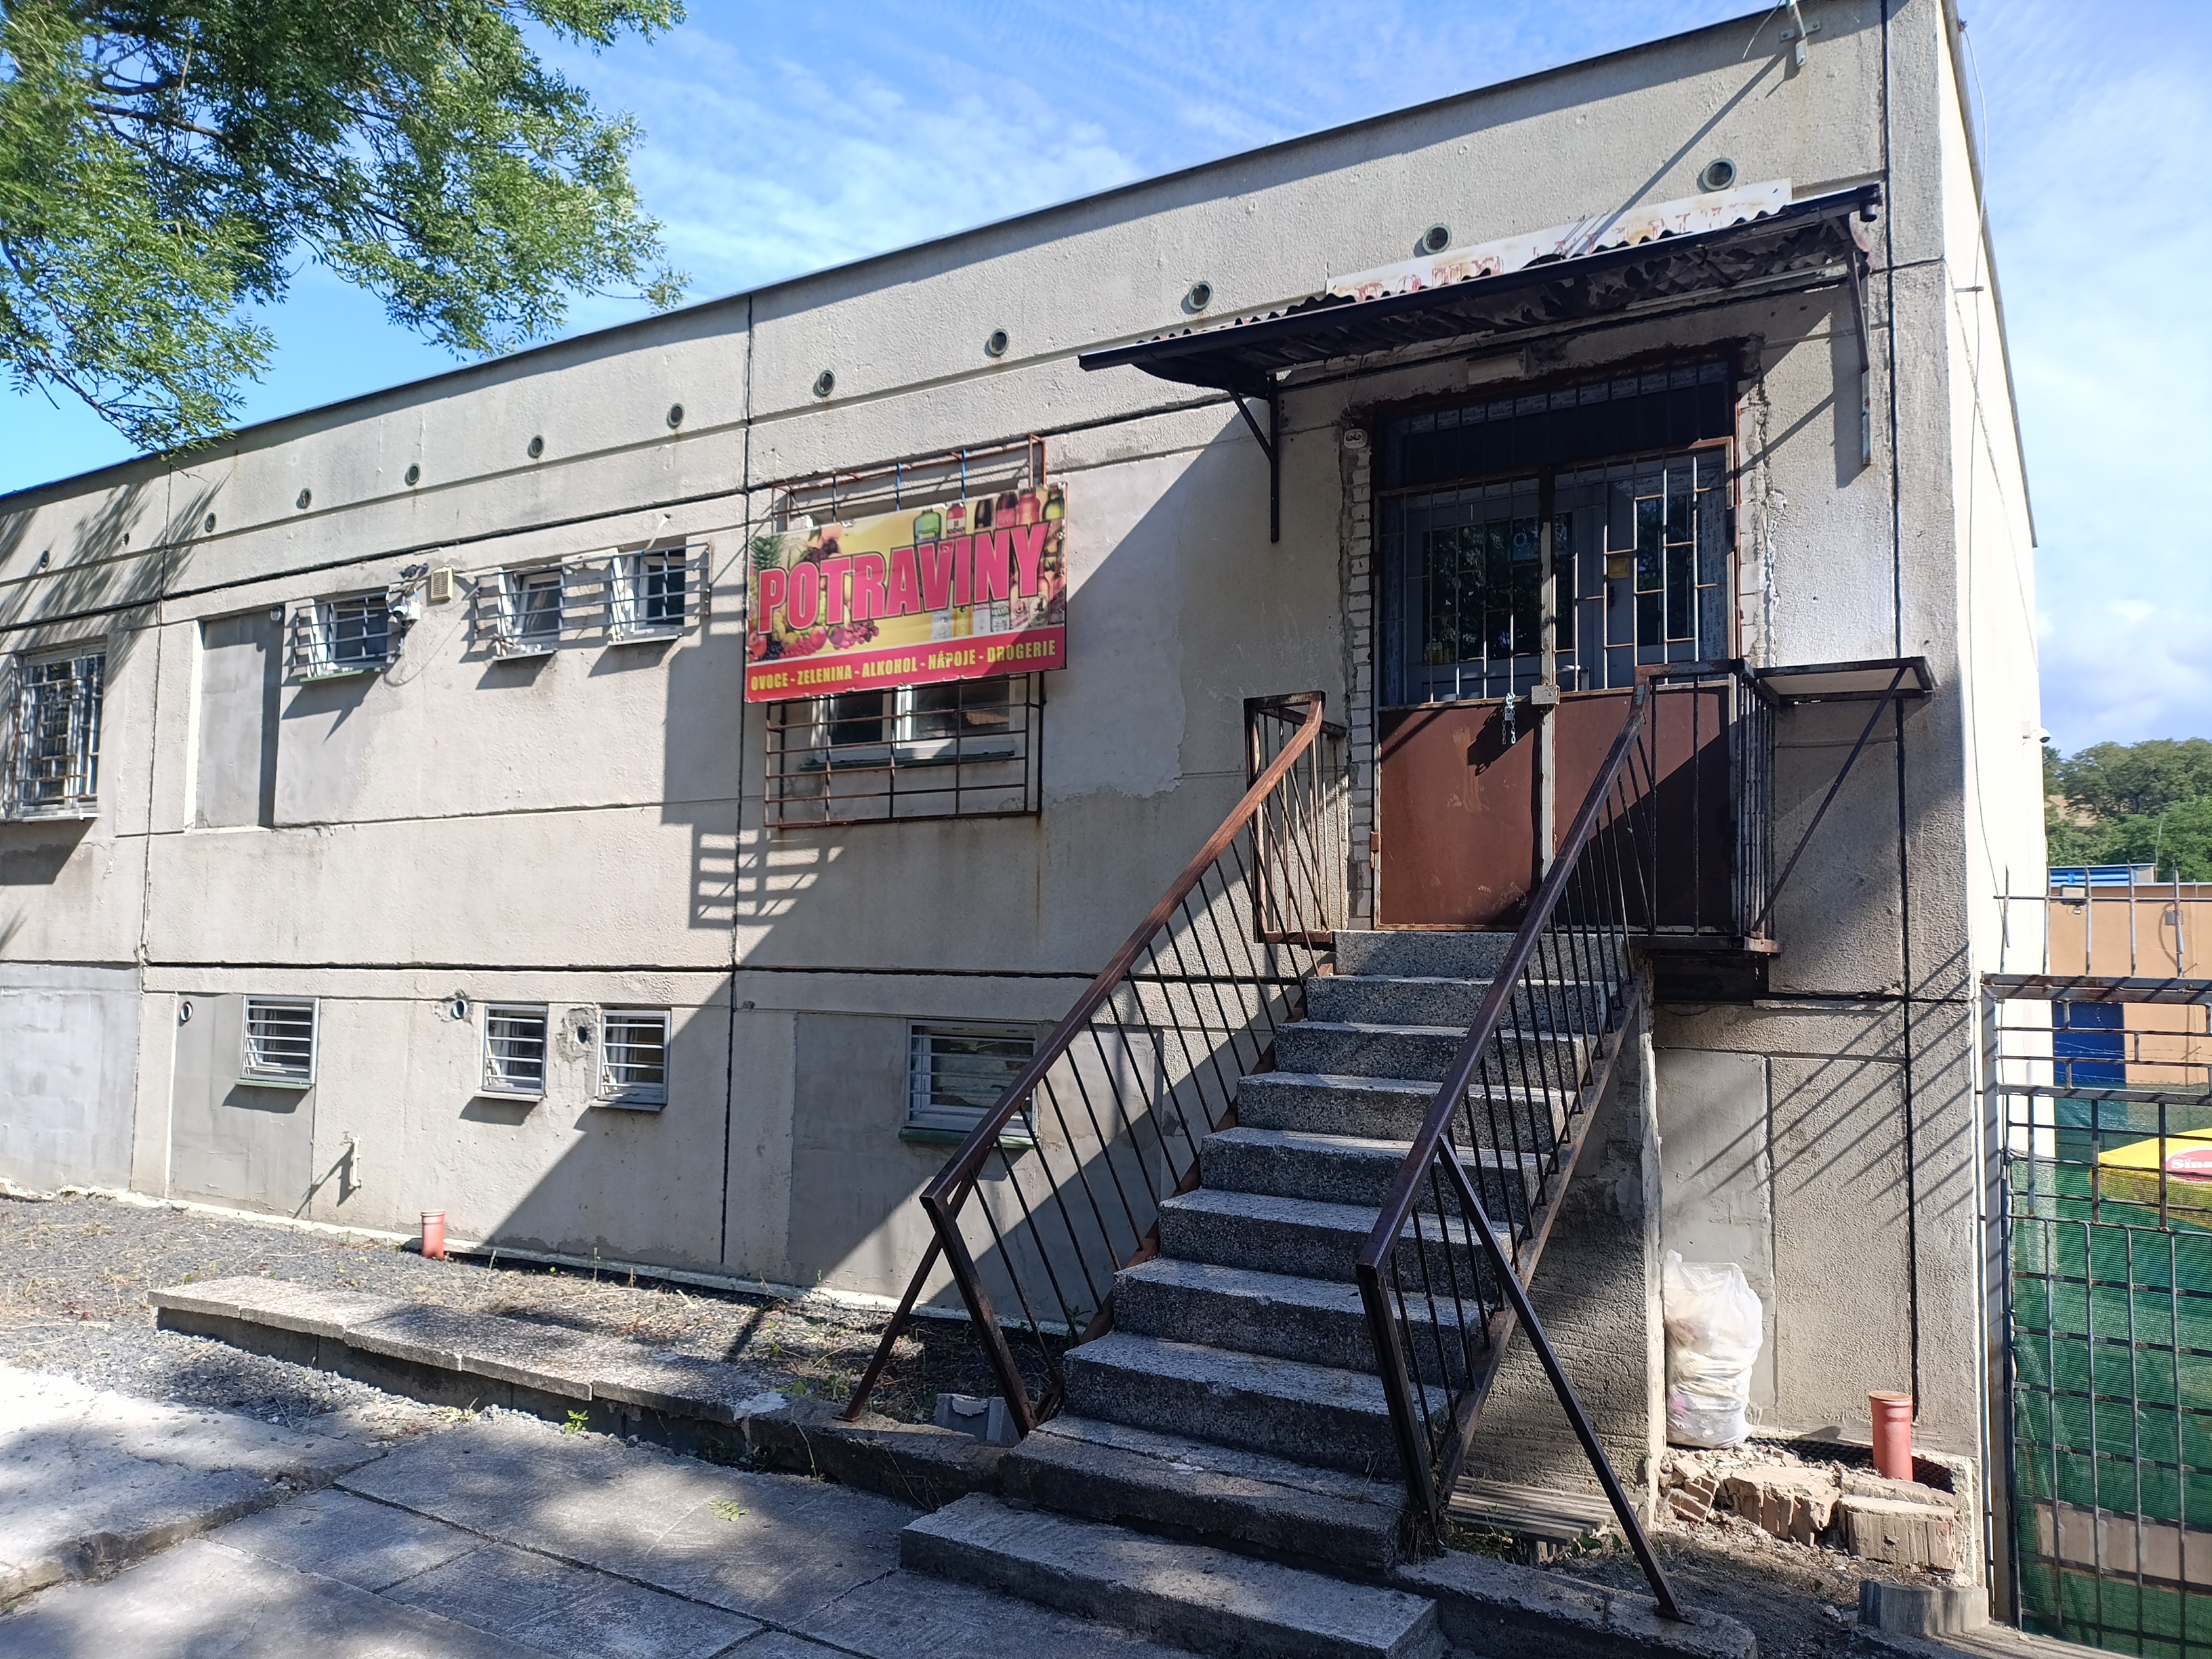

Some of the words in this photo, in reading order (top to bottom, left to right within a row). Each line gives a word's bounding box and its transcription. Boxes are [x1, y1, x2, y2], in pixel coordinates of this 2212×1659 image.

[758, 521, 1050, 634] POTRAVINY
[751, 673, 788, 691] OVOCE
[797, 665, 853, 685] ZELENINA
[862, 656, 917, 678] ALKOHOL
[928, 649, 975, 670] NÁPOJE
[987, 640, 1055, 663] DROGERIE
